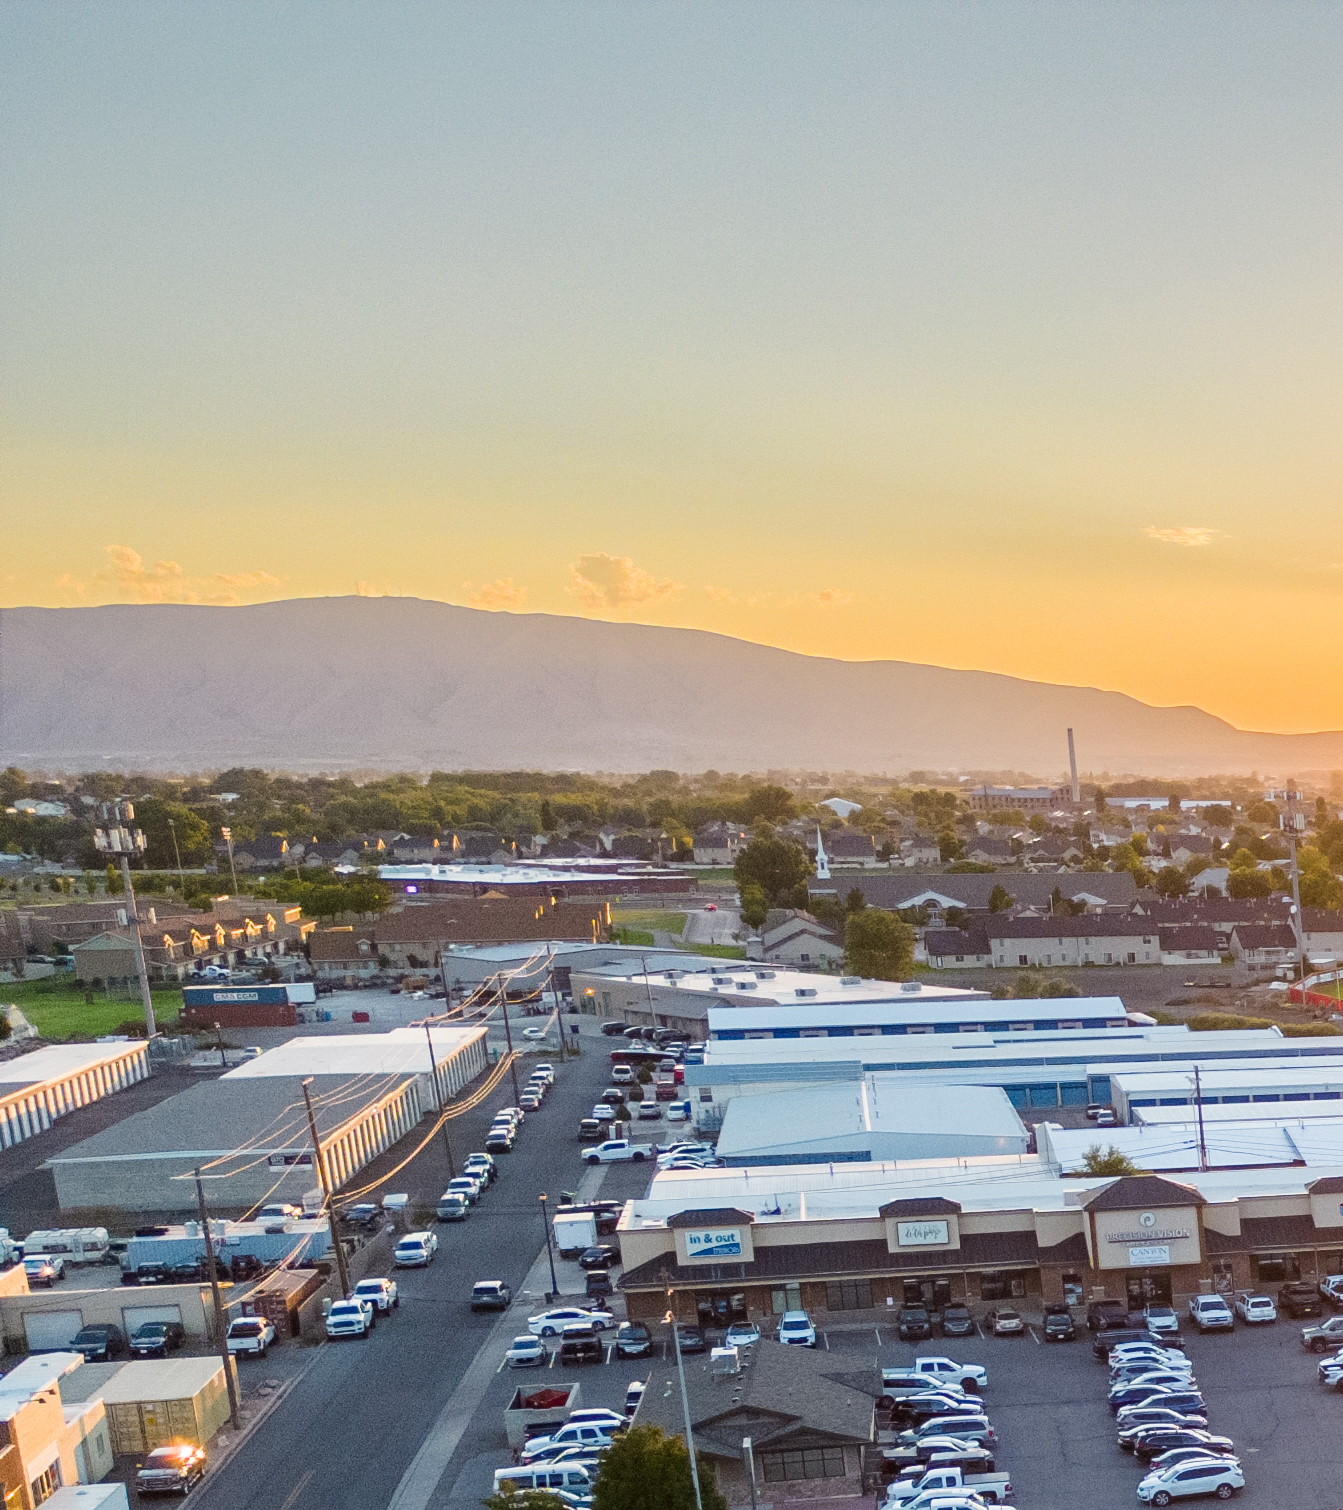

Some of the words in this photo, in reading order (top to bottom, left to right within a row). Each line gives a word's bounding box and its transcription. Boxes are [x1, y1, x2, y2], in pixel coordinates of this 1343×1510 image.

[1158, 1228, 1190, 1238] VISION
[689, 1233, 701, 1244] in
[704, 1233, 713, 1243] &
[715, 1233, 736, 1243] out
